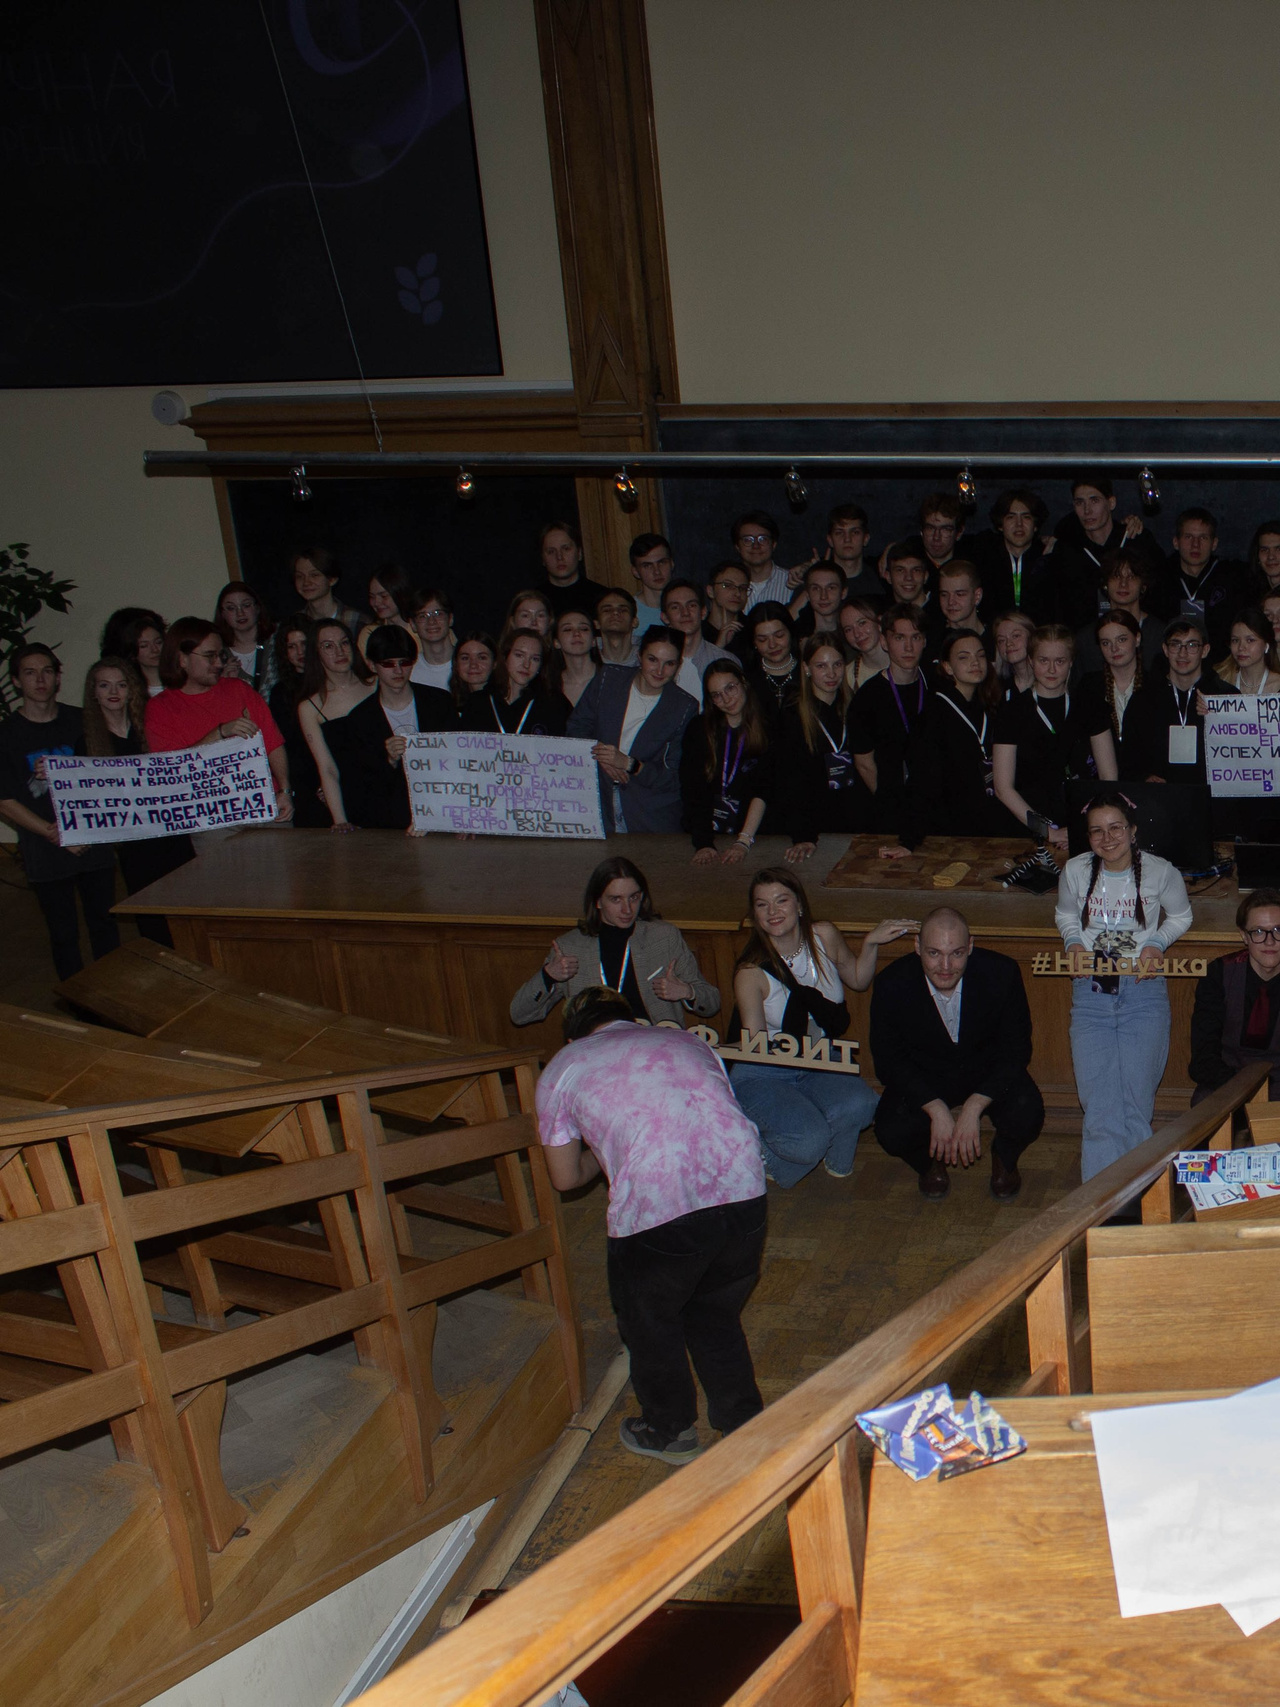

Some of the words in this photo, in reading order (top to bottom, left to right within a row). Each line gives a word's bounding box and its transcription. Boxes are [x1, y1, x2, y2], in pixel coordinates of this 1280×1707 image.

[1207, 700, 1247, 713] ДИМА
[1209, 723, 1268, 736] ЛЮБОВЬ
[1210, 746, 1262, 758] УСПЕХ
[1271, 747, 1280, 758] И
[49, 759, 85, 770] ПАША
[92, 758, 141, 767] СЛОВНО
[149, 752, 203, 767] ЗВЕЗДА
[410, 760, 431, 771] ОН
[439, 760, 449, 771] К
[459, 760, 496, 773] ЦЕЛИ
[54, 779, 72, 790] ОН
[79, 777, 125, 789] ПРОФИ
[132, 777, 141, 787] И
[147, 763, 241, 787] ВДОХНОВЛЯЕТ
[137, 766, 180, 777] ГОРИТ
[189, 763, 197, 772] В
[1212, 769, 1274, 782] БОЛЕЕМ
[192, 777, 225, 792] ВСЕХ
[495, 774, 523, 786] ЭТО
[1263, 781, 1273, 792] В
[413, 782, 479, 795] СТЕТХЕМ
[486, 784, 550, 799] ПОМОЖЕТ
[58, 798, 100, 810] УСПЕХ
[106, 798, 131, 807] ЕГО
[135, 786, 230, 806] ОПРЕДЕЛЕННО
[470, 796, 496, 807] ЕМУ
[61, 811, 76, 831] И
[148, 792, 266, 824] ПОБЕДИТЕЛЯ
[165, 819, 200, 832] ПАША
[208, 805, 274, 826] ЗАБЕРЕТ!
[415, 805, 434, 817] НА
[442, 806, 498, 819] ПЕРВОЕ
[506, 809, 552, 821] МЕСТО
[452, 819, 508, 830] БЫСТРО
[1031, 950, 1208, 979] #НЕнаучка
